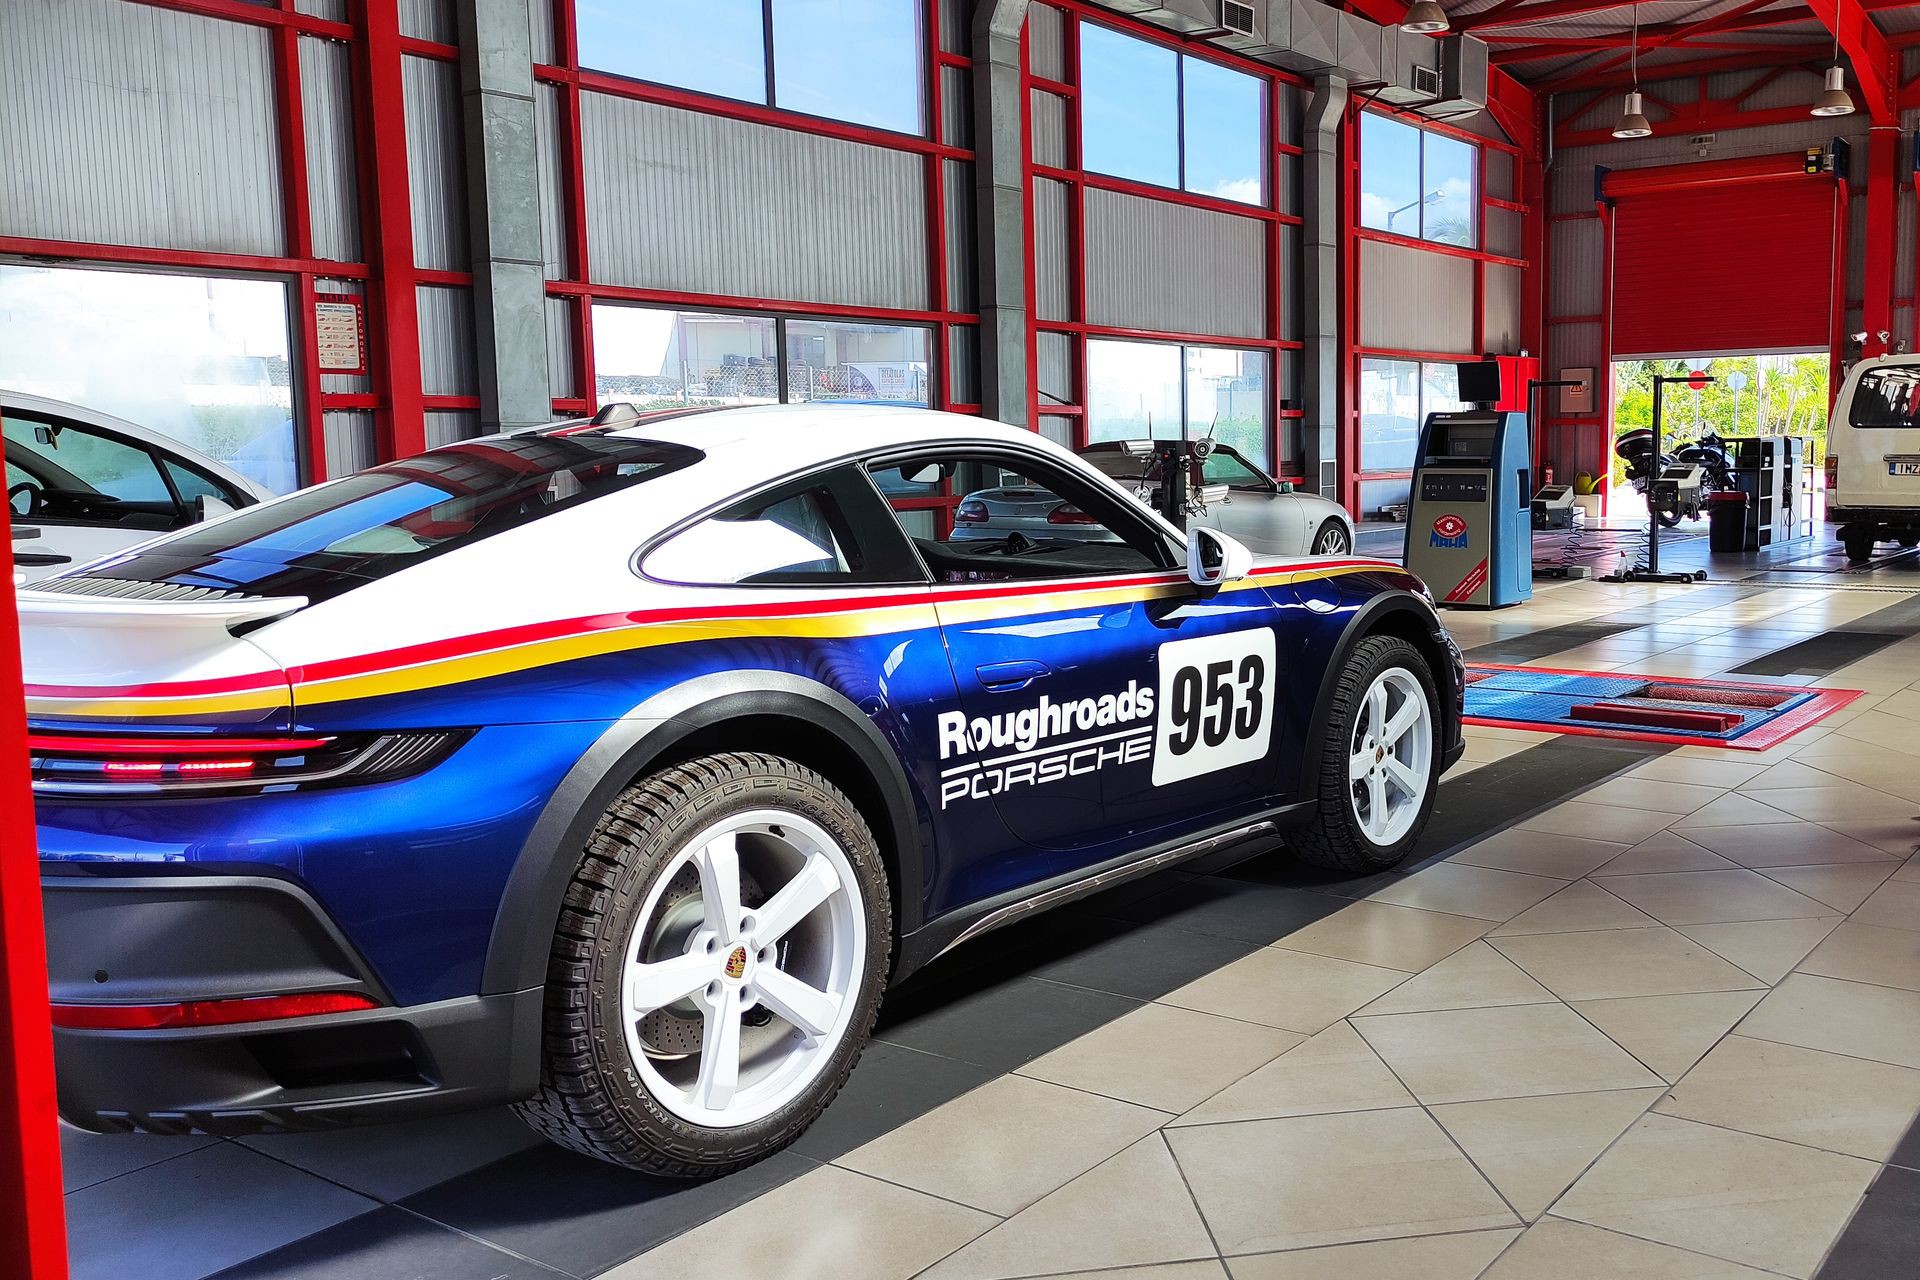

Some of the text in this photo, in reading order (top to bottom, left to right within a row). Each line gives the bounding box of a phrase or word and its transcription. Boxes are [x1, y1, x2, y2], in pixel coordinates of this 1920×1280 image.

[1429, 528, 1468, 549] MAHA
[938, 679, 1155, 760] Roughroads
[1168, 654, 1265, 756] 953
[940, 735, 1152, 811] PORSCHE
[792, 798, 865, 867] SCORPION
